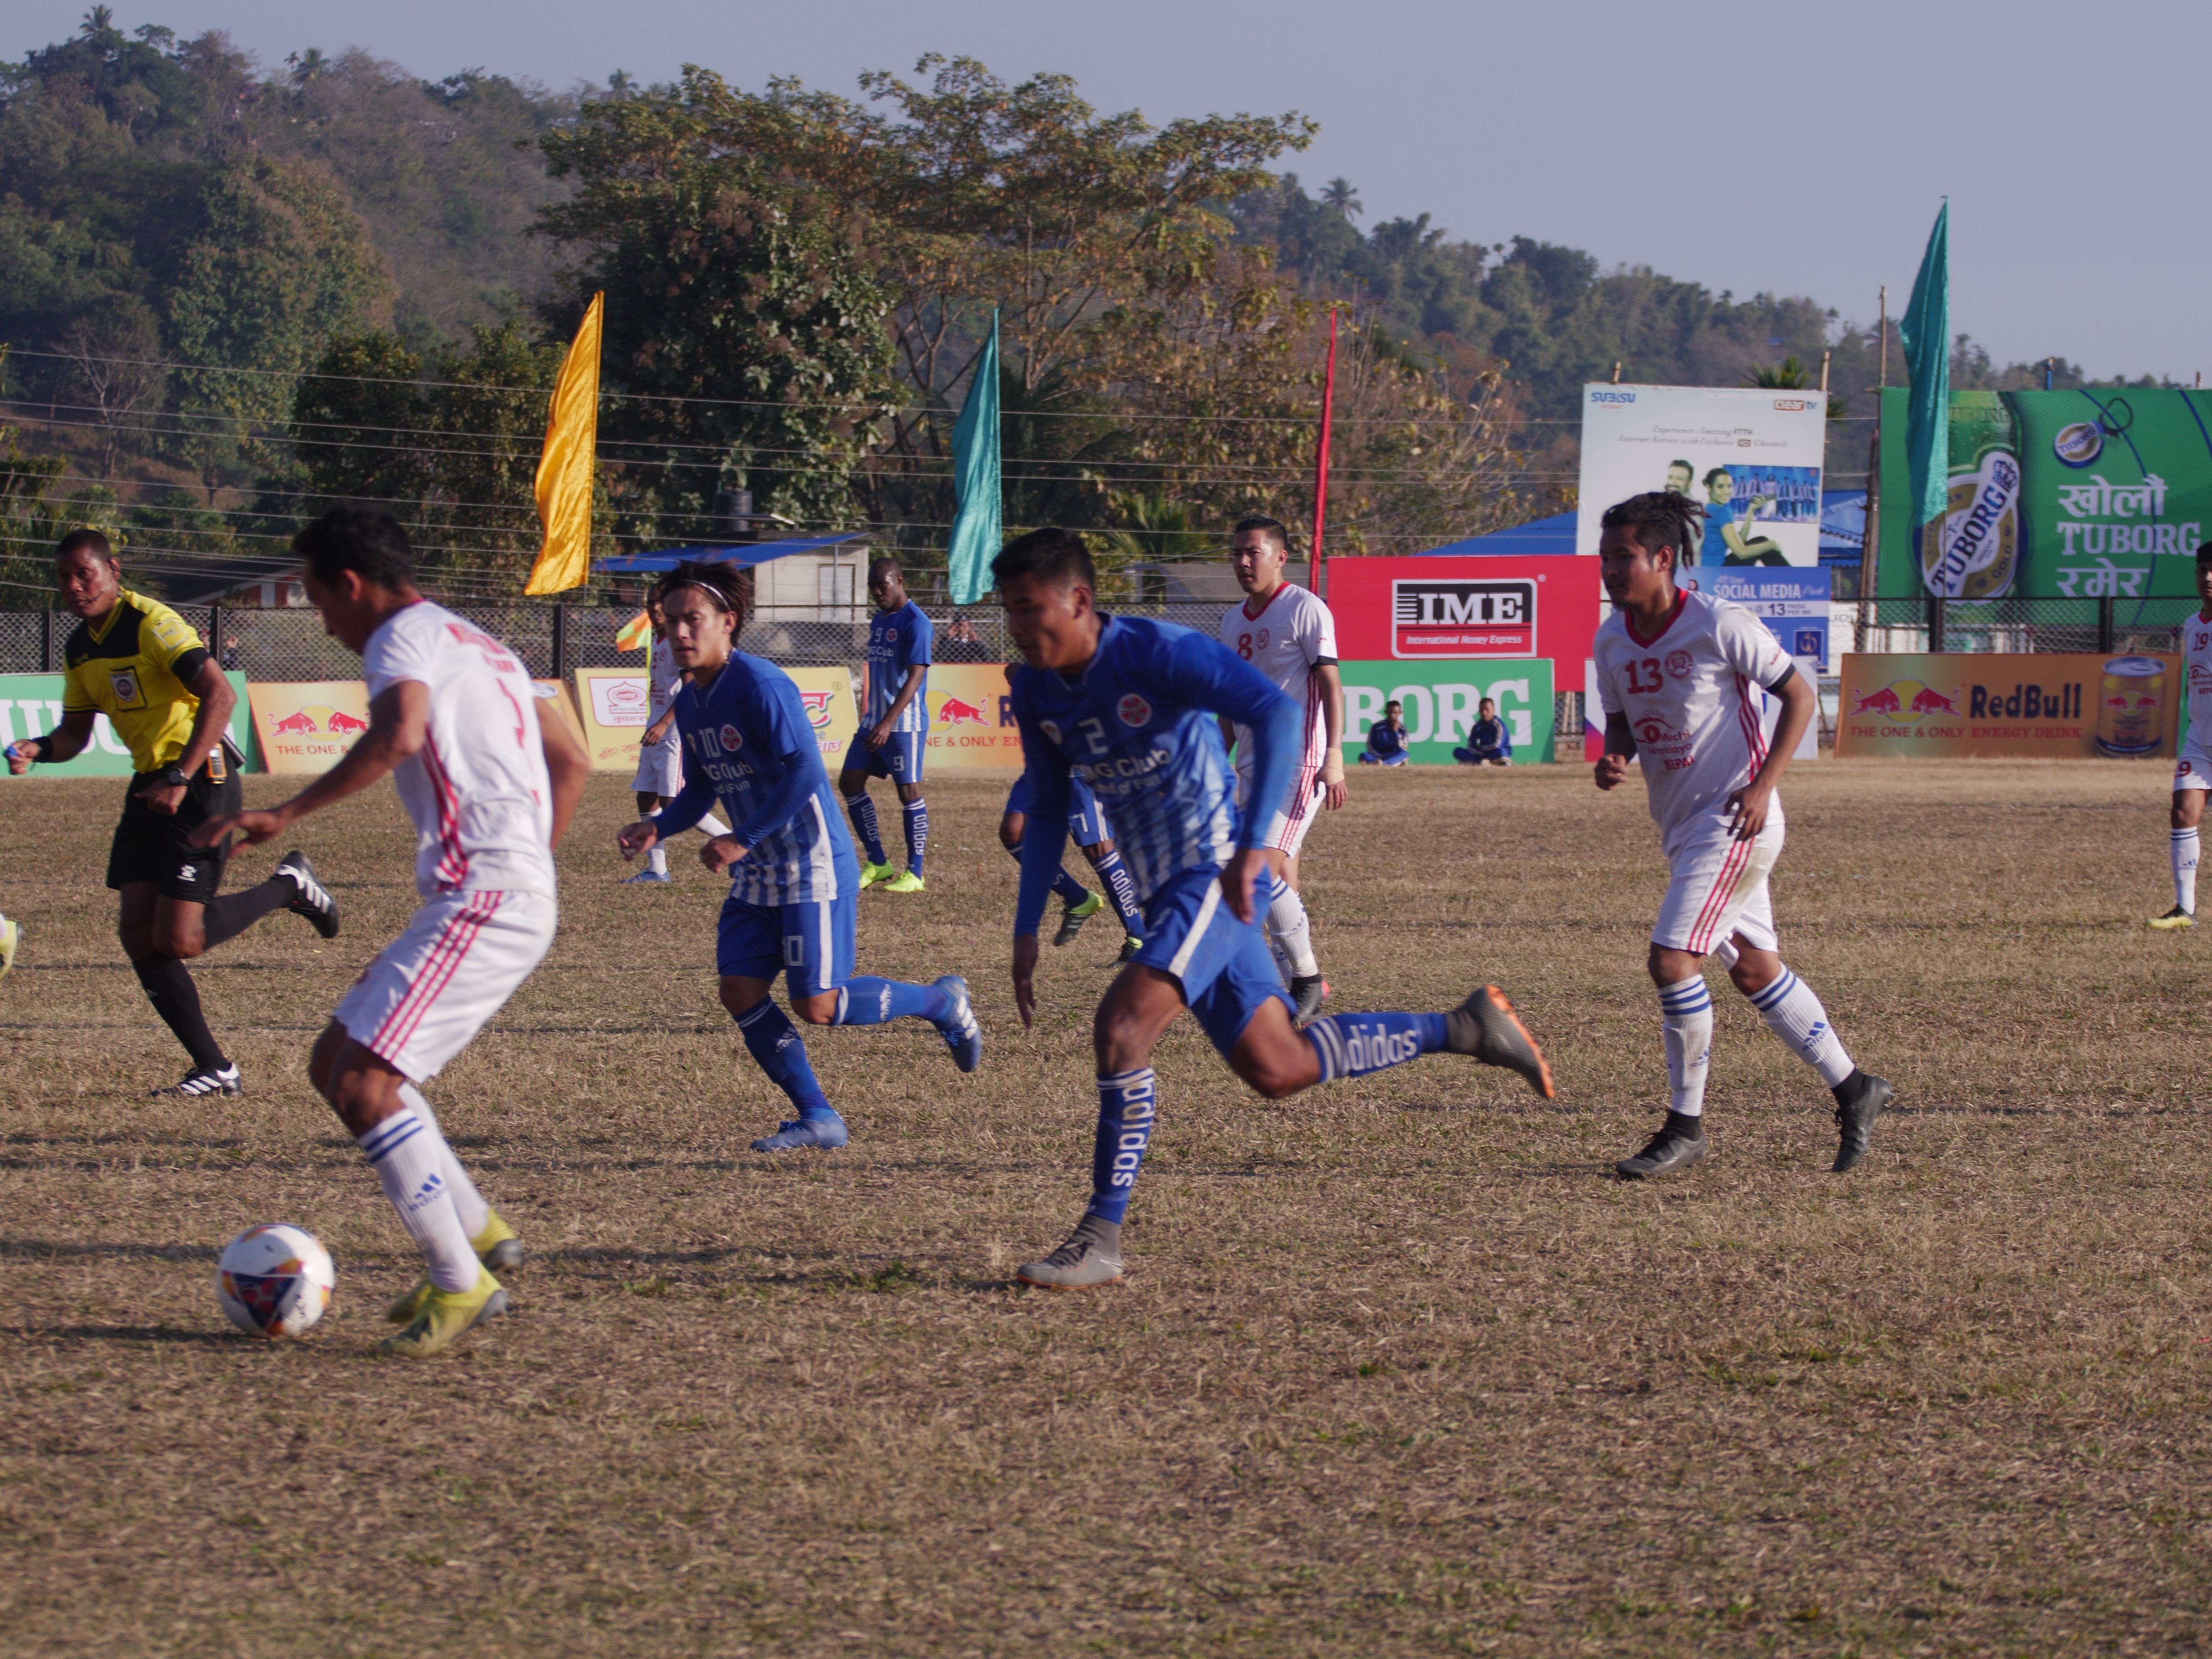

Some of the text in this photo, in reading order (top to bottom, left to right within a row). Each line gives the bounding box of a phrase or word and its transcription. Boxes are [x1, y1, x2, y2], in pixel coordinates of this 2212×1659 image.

[1806, 401, 1817, 410] tv
[1932, 485, 2007, 594] TUBORG
[2057, 522, 2201, 557] TUBORG
[1992, 545, 2013, 580] GOLD
[1714, 584, 1757, 599] SOCIAL
[1760, 584, 1802, 599] MEDIA
[1418, 592, 1523, 625] IME
[1769, 603, 1786, 616] 13
[874, 627, 884, 643] 9
[1237, 633, 1253, 661] 8
[1406, 635, 1523, 645] International Money Express
[2193, 632, 2208, 651] 19
[1624, 658, 1664, 694] 13
[1343, 679, 1532, 746] BORG
[1970, 683, 2082, 720] RedBull
[698, 728, 722, 759] 10
[926, 737, 942, 747] NE
[946, 737, 956, 747] &
[960, 736, 997, 747] ONLY
[1077, 717, 1109, 755] 2
[1850, 727, 2082, 738] THE ONE & ONLY ENERGY DRINK
[276, 745, 304, 755] THE
[307, 745, 337, 754] ONE
[893, 756, 904, 771] 9
[861, 802, 880, 842] adidas
[913, 814, 929, 856] adidas
[1110, 868, 1138, 917] adidas
[1111, 1081, 1155, 1187] adidas
